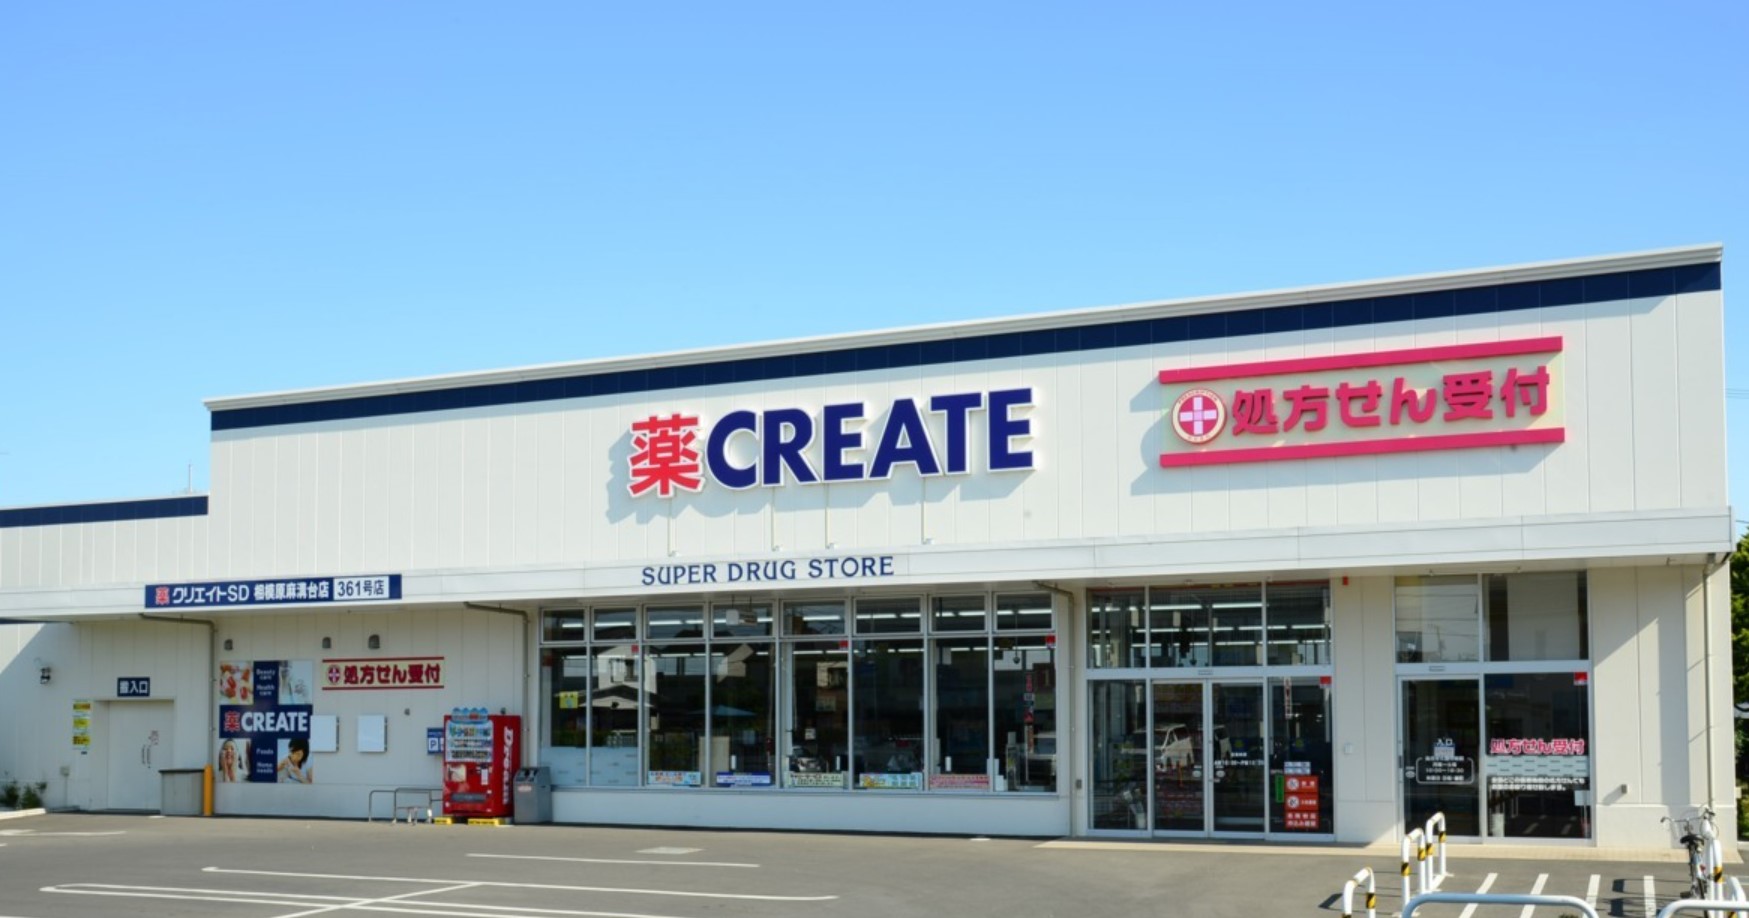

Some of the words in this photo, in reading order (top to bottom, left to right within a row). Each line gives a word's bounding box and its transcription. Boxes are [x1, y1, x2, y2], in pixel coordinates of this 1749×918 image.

[1231, 365, 1550, 437] 処方せん受付
[628, 413, 701, 496] 薬
[706, 387, 1034, 489] CREATE
[641, 563, 718, 587] SUPER
[727, 558, 797, 584] DRUG
[807, 555, 895, 579] STORE
[172, 584, 250, 604] クリエイトSD
[337, 578, 385, 598] 361号店
[343, 663, 441, 685] 処方せん受付
[240, 711, 309, 733] CREATE
[1489, 738, 1585, 755] 処方せん受付
